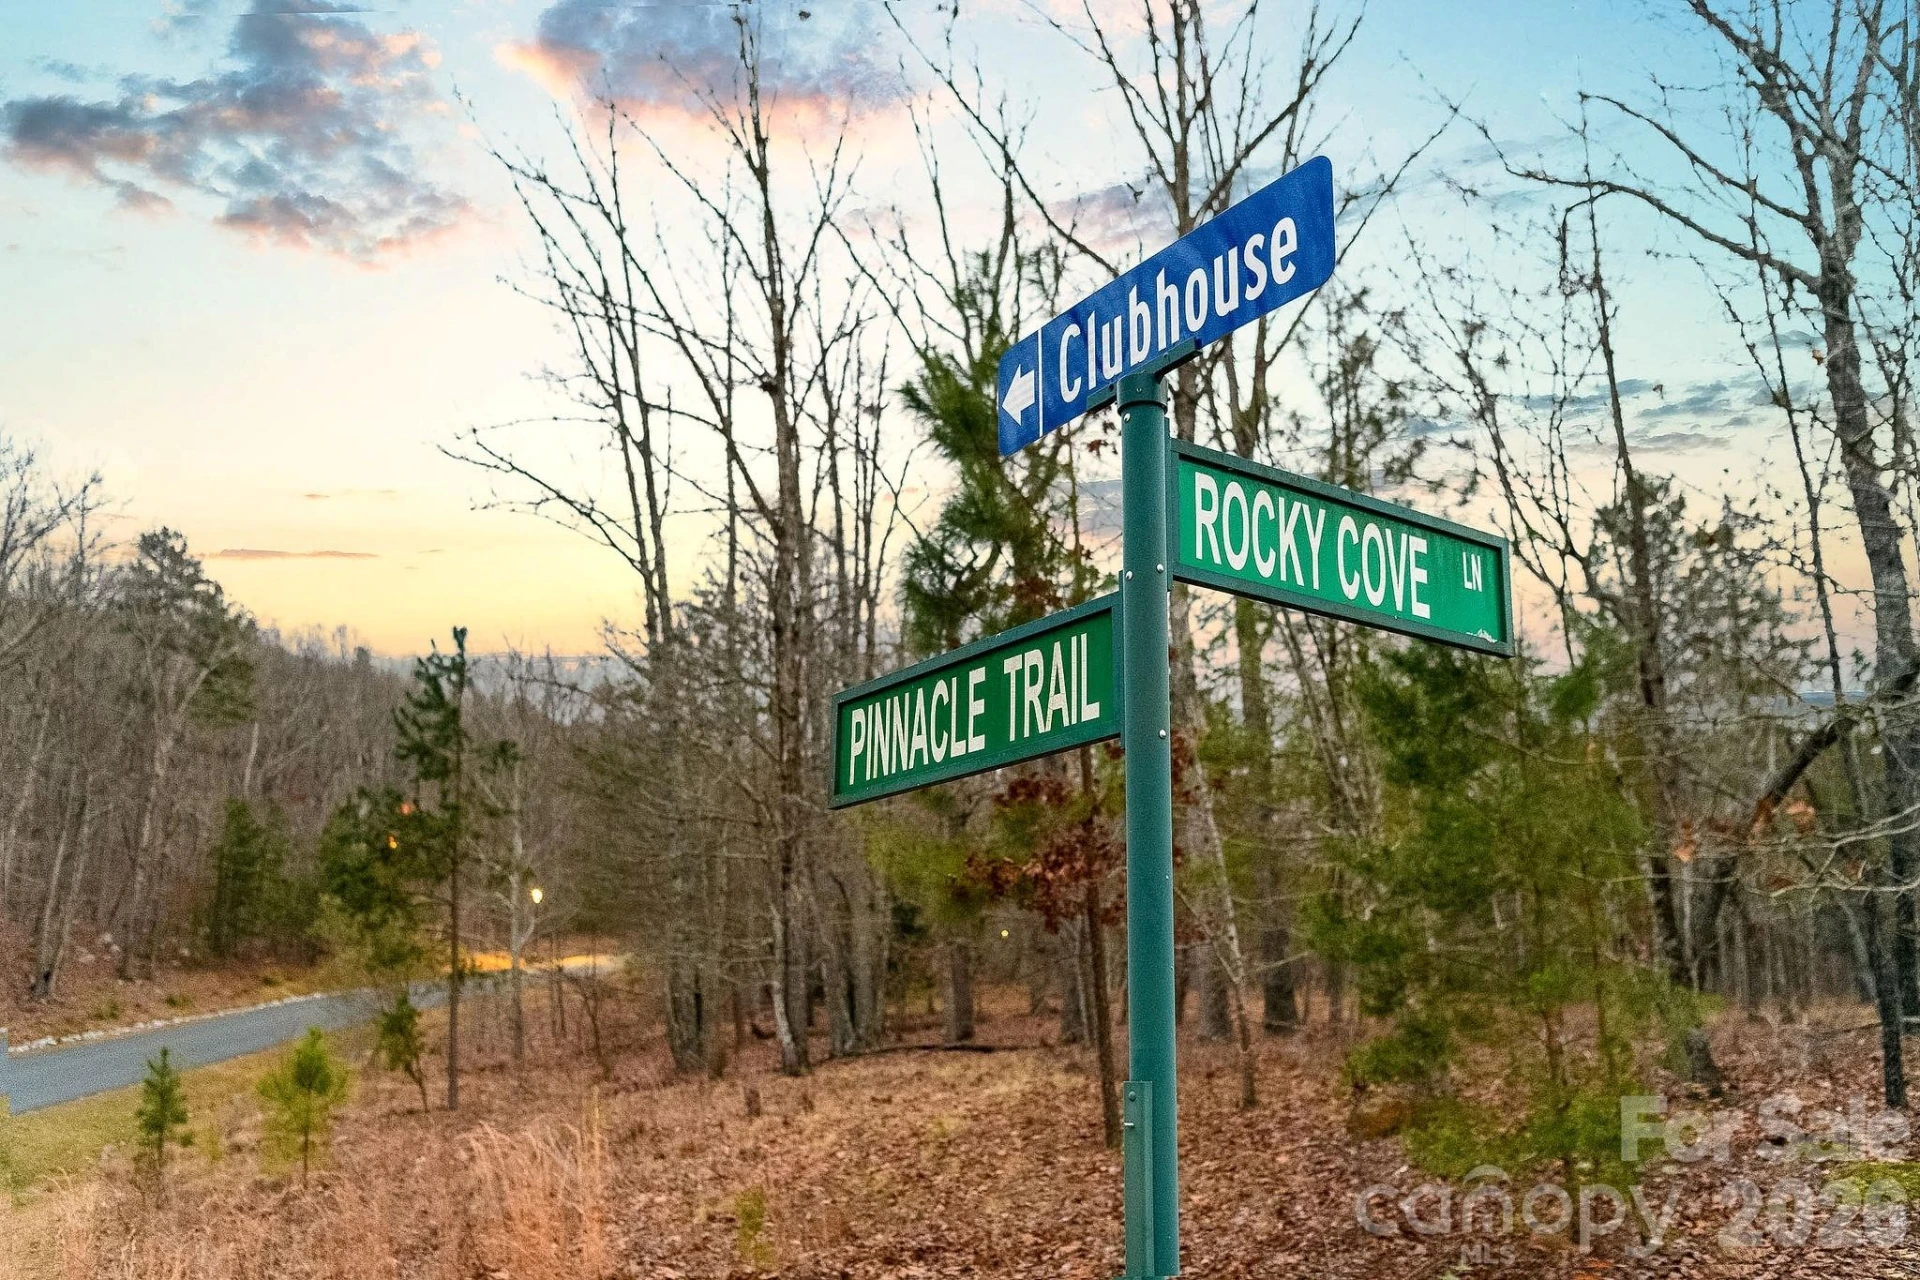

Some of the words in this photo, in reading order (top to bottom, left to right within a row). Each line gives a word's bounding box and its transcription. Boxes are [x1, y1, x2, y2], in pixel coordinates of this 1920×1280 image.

[1059, 217, 1297, 404] Clubhouse
[1195, 472, 1326, 591] ROCKY
[1337, 515, 1430, 619] COVE
[1463, 551, 1482, 592] LN
[849, 666, 986, 785] PINNACLE
[1003, 633, 1100, 742] TRAIL
